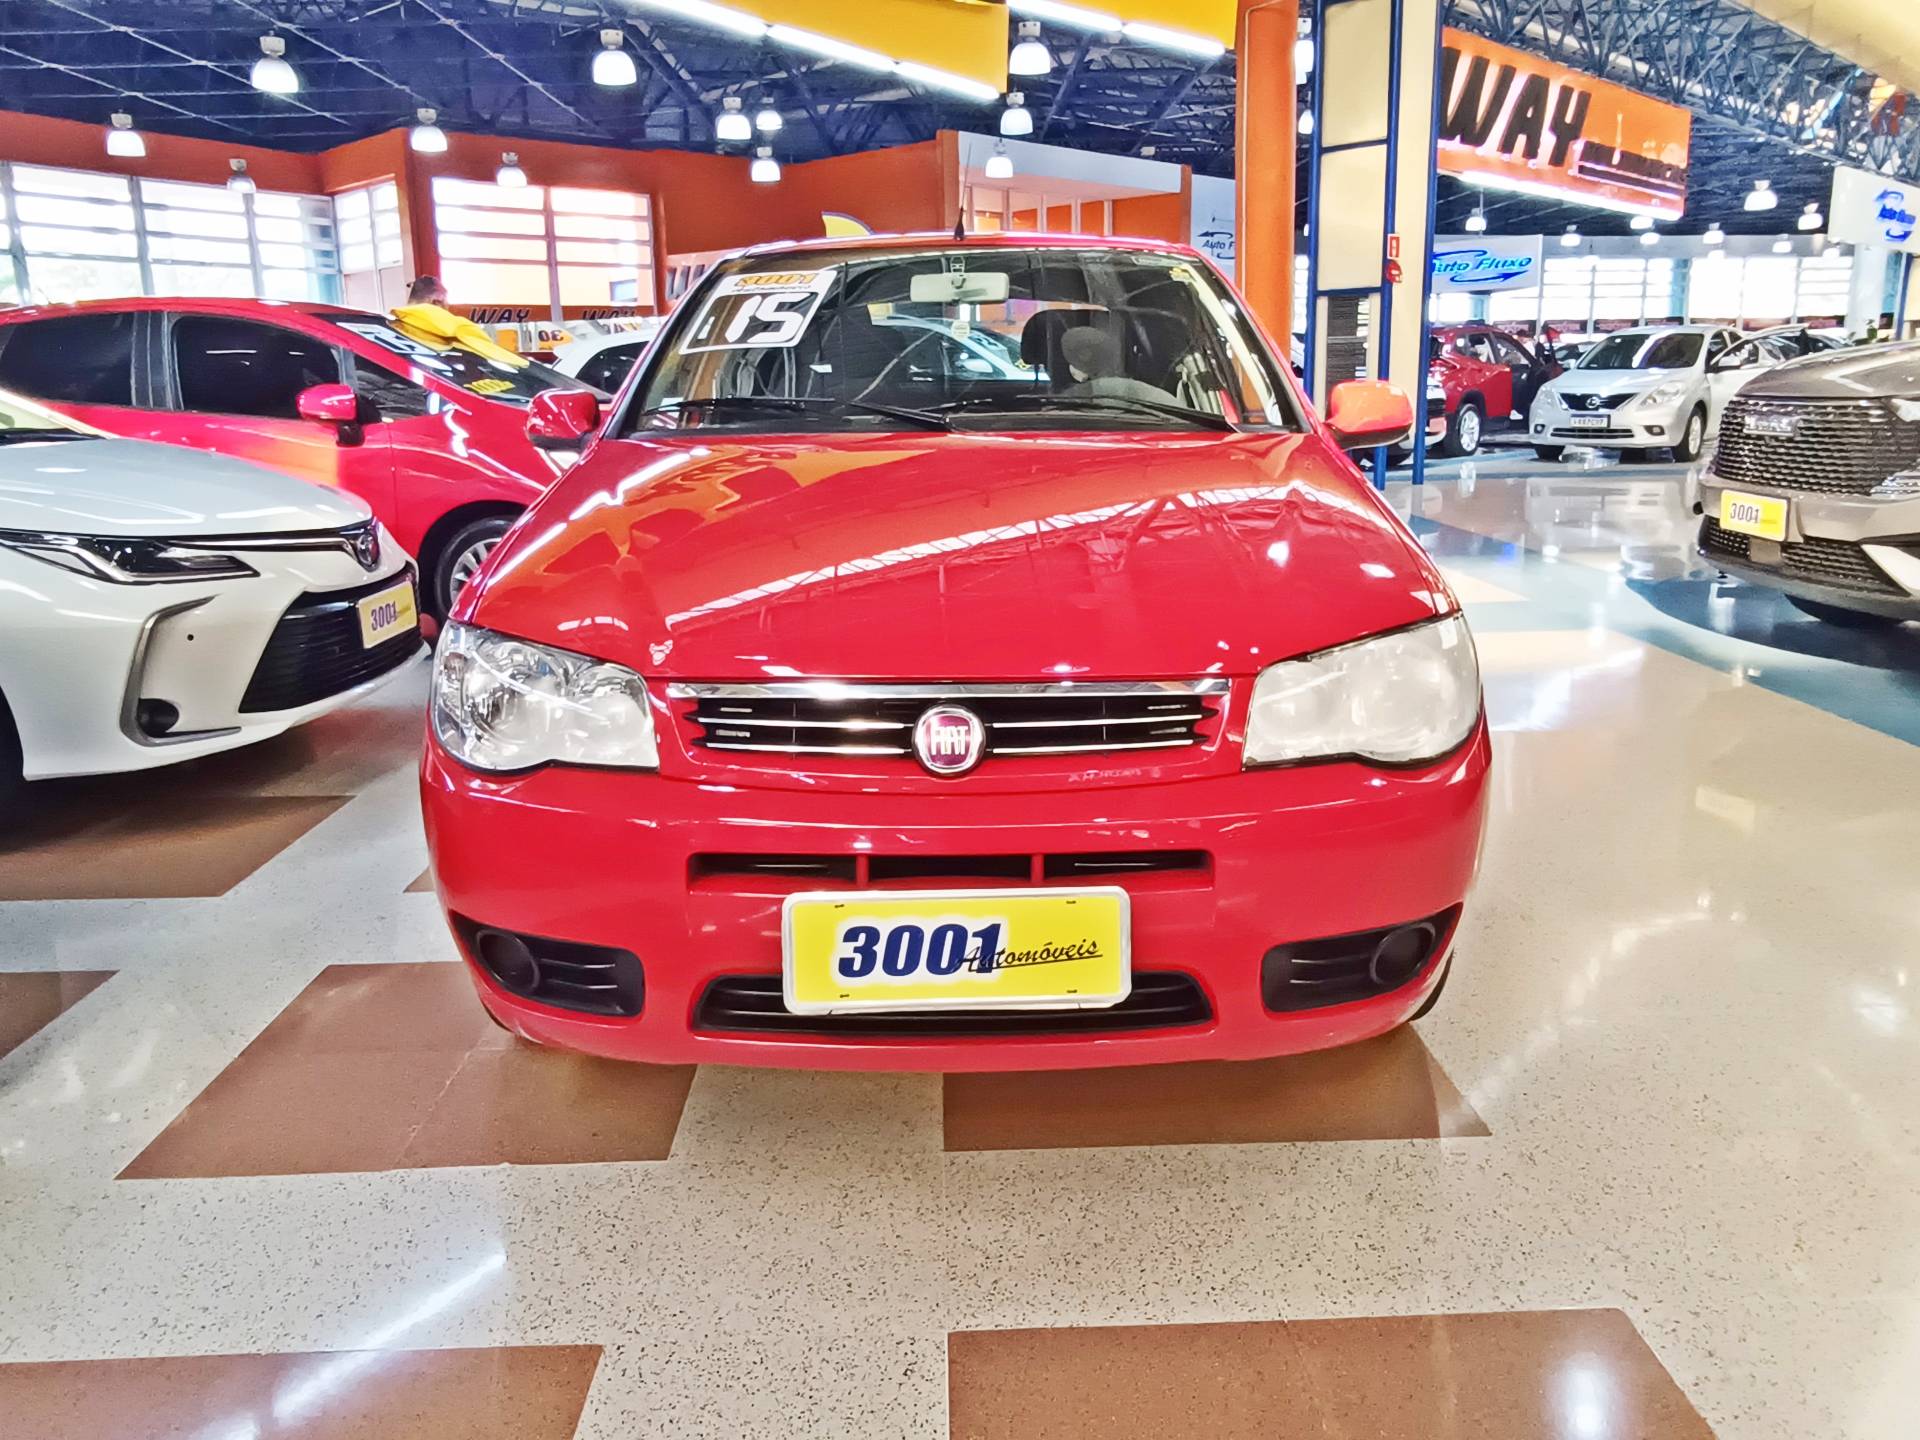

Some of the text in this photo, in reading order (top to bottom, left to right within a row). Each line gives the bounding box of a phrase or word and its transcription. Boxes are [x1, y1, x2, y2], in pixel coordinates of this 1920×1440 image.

[1438, 46, 1593, 168] WAY
[1202, 239, 1226, 249] Auto
[1475, 257, 1533, 270] Fluxo
[471, 308, 530, 323] WAY
[1730, 503, 1760, 524] 3001
[371, 600, 397, 631] 3001
[930, 725, 969, 755] FIAT
[838, 923, 1103, 978] 3001 Automóveis
